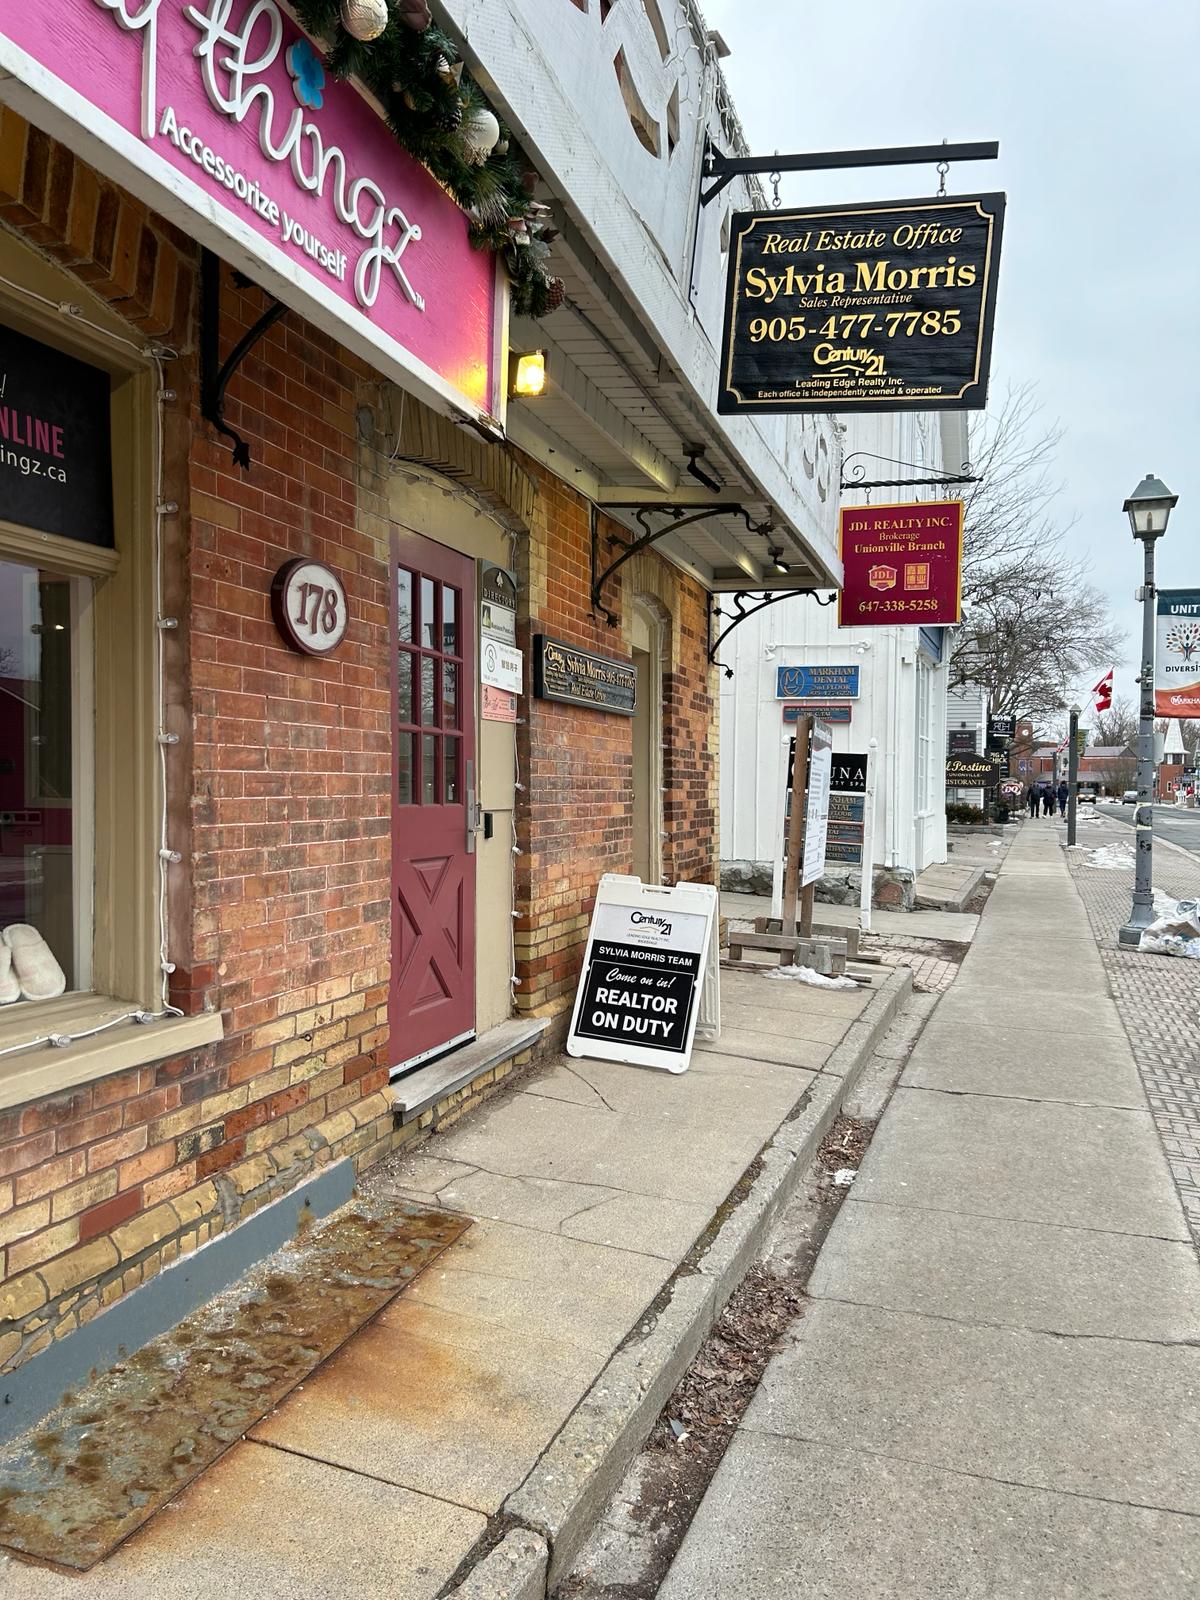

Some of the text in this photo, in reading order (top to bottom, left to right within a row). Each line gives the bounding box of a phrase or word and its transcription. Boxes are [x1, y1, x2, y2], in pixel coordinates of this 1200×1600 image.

[159, 106, 348, 283] Accessorize yourself
[761, 223, 963, 255] Real Estate Office
[745, 256, 977, 303] Sylvia Morris
[798, 293, 913, 309] Sales Representative
[749, 310, 962, 343] 905-477-7785
[795, 377, 905, 388] Leading Edge Realty Inc.
[758, 386, 942, 399] Each office is independently owned & operated
[0, 406, 65, 459] NLINE
[0, 444, 67, 483] ingz.ca
[848, 516, 953, 531] JDL REALTY INC.
[879, 532, 920, 541] Brokerage
[854, 541, 945, 553] Unionville Branch
[872, 571, 893, 580] JDL
[296, 582, 338, 635] 178
[859, 600, 938, 612] 647-338-5258
[1170, 604, 1200, 614] UNIT
[566, 654, 586, 676] Sylvia
[586, 660, 606, 682] Morris
[809, 668, 855, 676] MARKHAM
[1165, 664, 1200, 673] DIVERSI
[814, 676, 848, 684] DENTAL
[1170, 694, 1200, 706] MARKHA
[951, 761, 993, 772] Postino
[831, 803, 851, 811] NTAL
[598, 946, 693, 967] SYLVIA MORRIS TEAM
[605, 967, 677, 989] Come on in!
[595, 987, 678, 1015] REALTOR
[592, 1010, 674, 1038] ON DUTY
